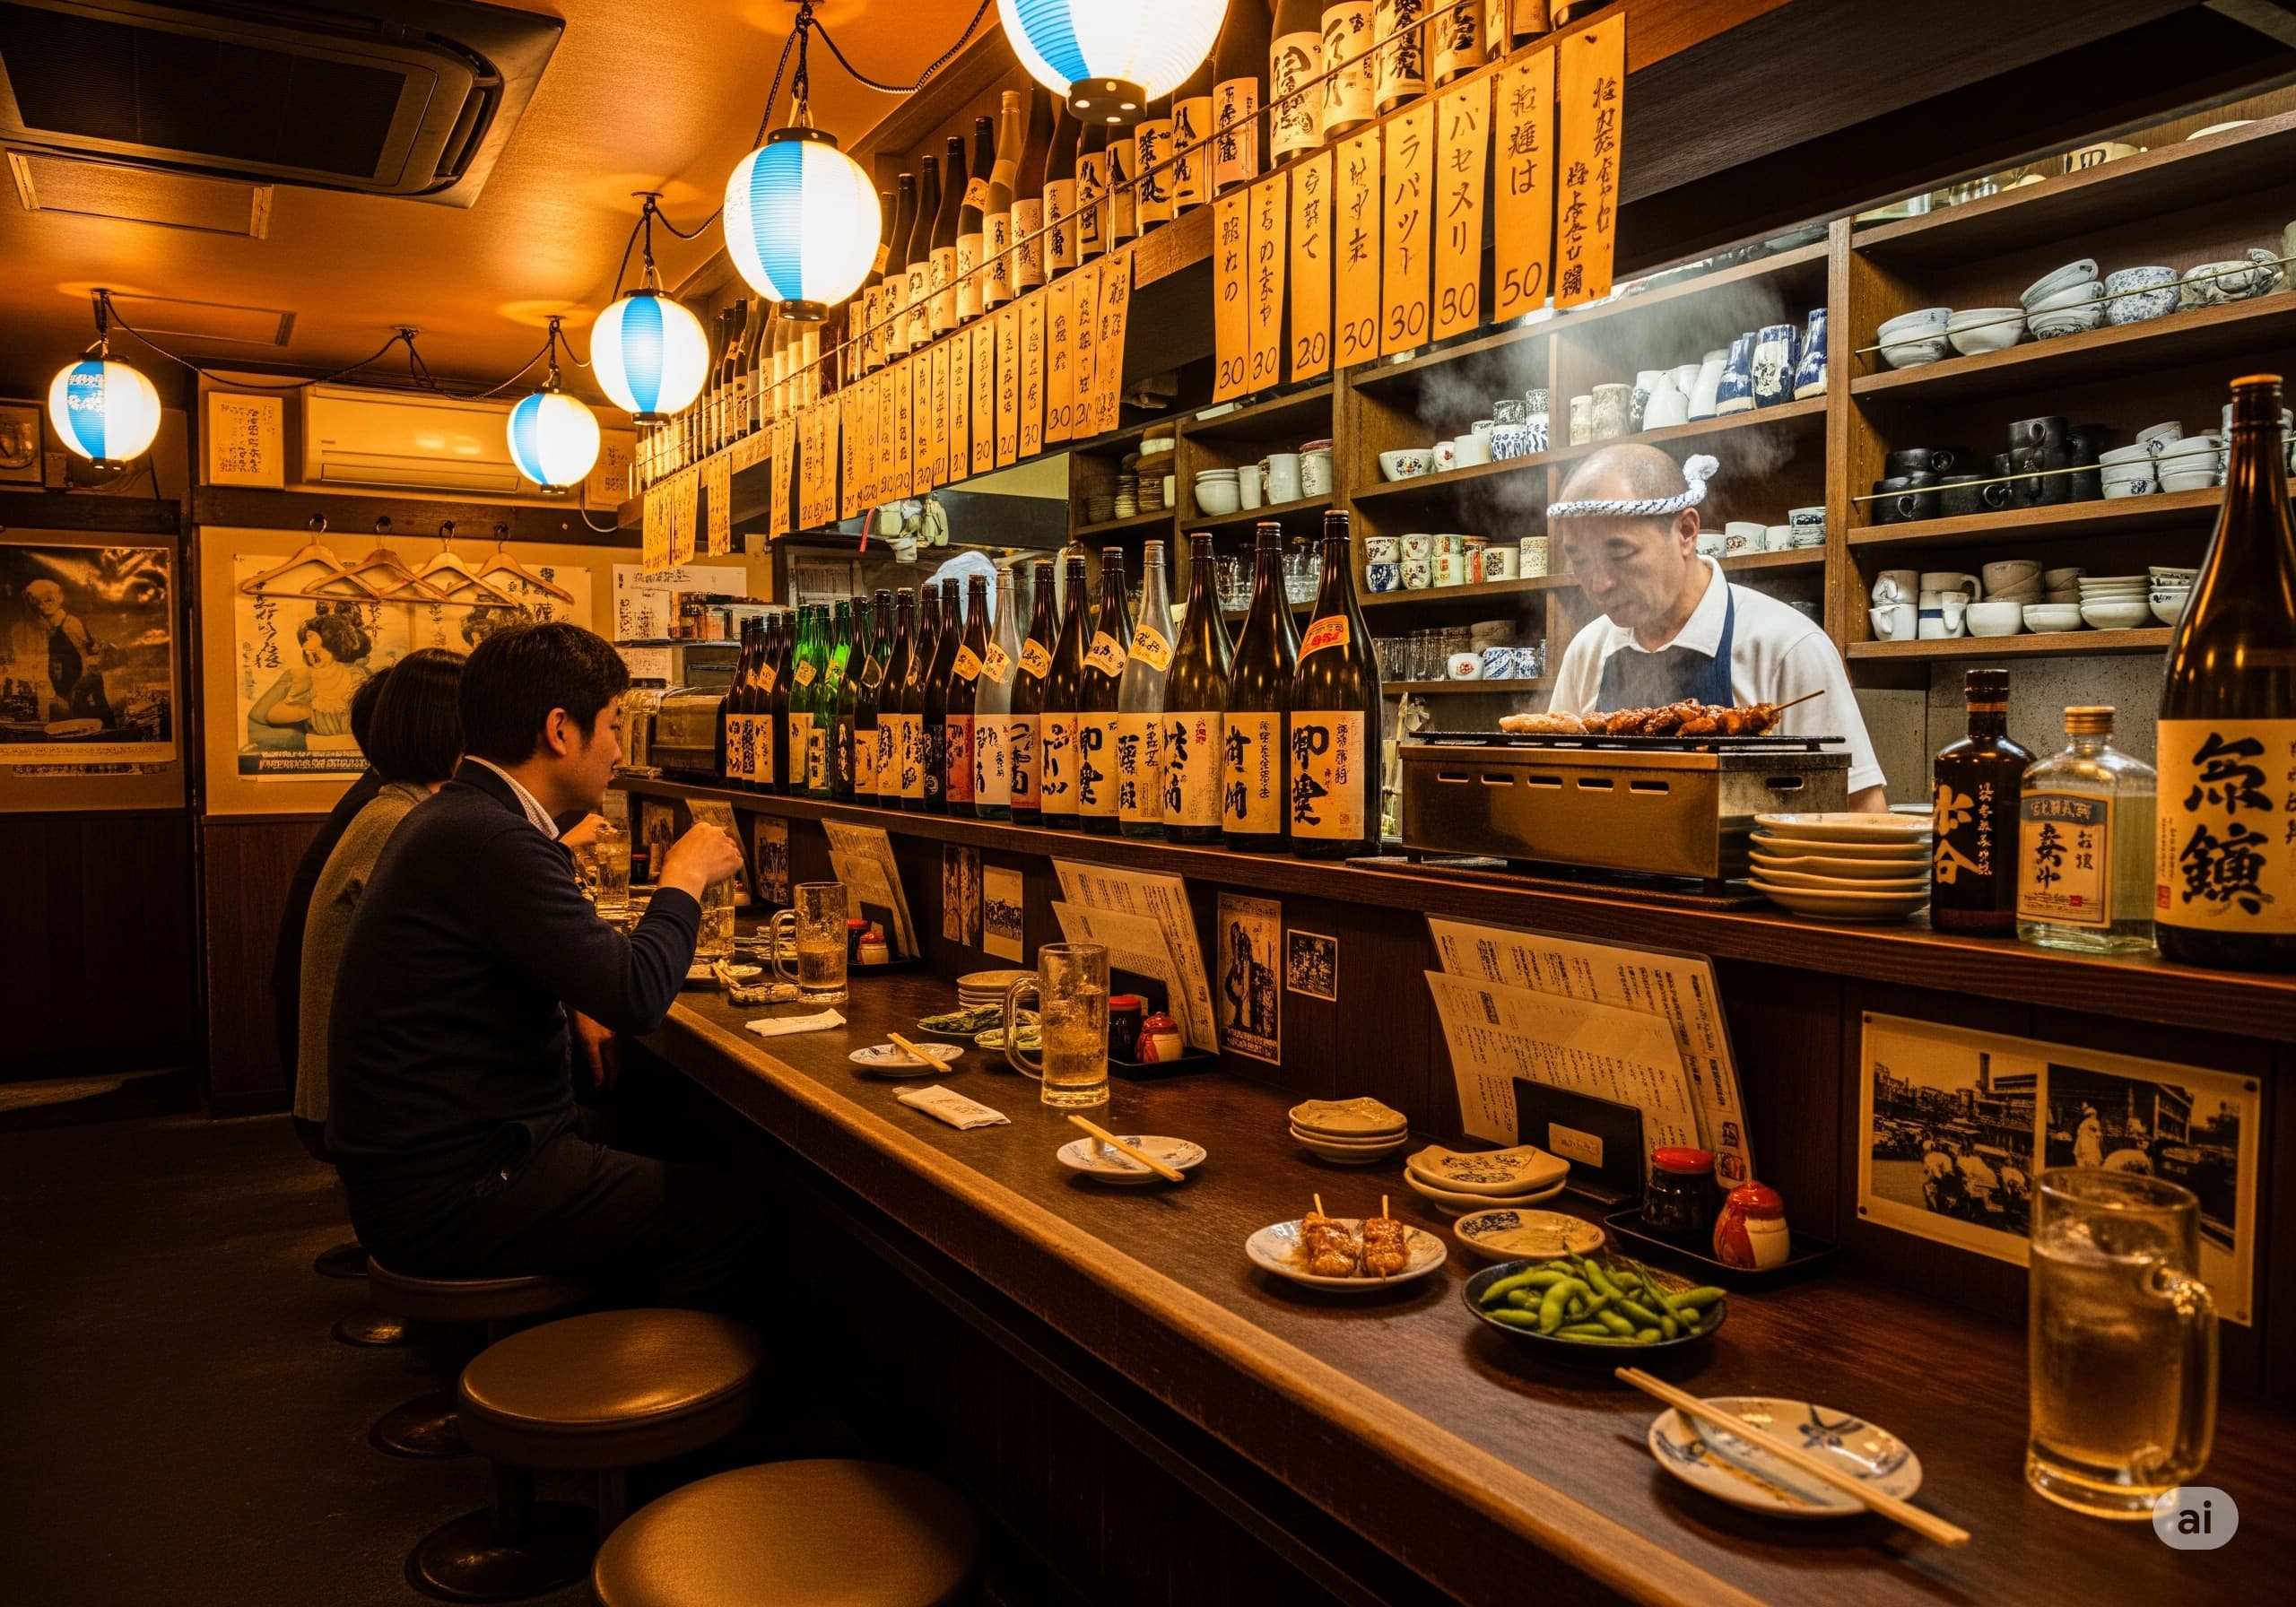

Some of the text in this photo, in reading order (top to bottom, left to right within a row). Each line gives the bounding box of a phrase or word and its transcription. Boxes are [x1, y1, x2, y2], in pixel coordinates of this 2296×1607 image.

[1502, 261, 1542, 307] 50
[1344, 318, 1374, 357] 30
[1389, 301, 1424, 341] 30
[1253, 346, 1277, 380] 30
[1297, 332, 1326, 369] 20
[1220, 356, 1245, 389] 30
[1048, 405, 1071, 430] 30
[1000, 434, 1015, 456] 20
[1024, 423, 1039, 447] 30
